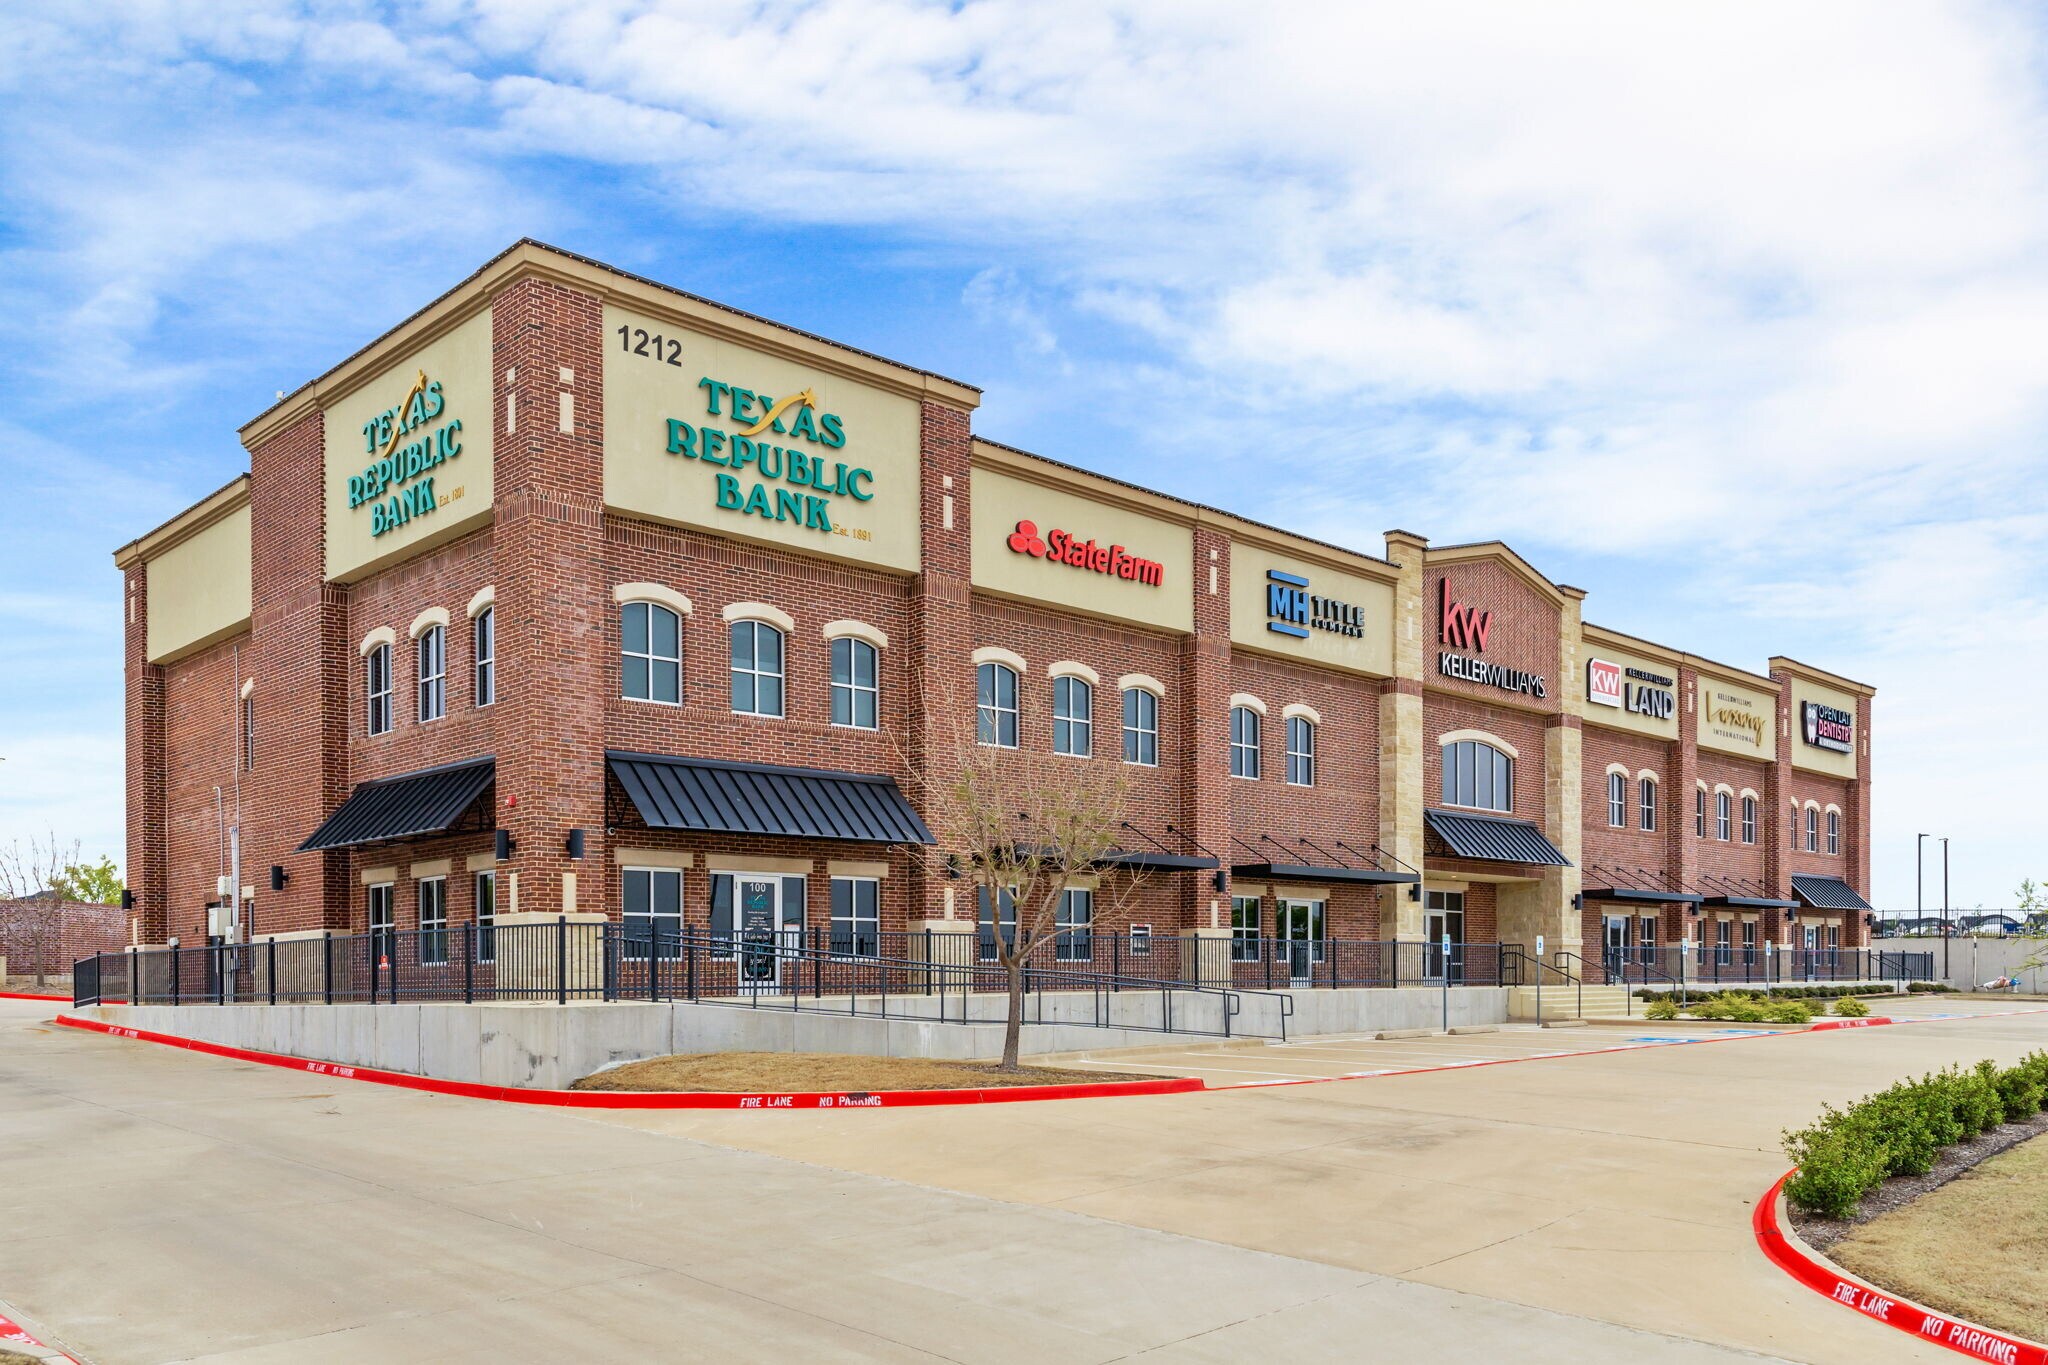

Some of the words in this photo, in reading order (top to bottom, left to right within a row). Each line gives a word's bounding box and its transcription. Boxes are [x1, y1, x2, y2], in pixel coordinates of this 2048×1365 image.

[618, 324, 682, 367] 1212
[362, 381, 445, 453] TEXAS
[698, 376, 847, 449] TEXAS
[347, 419, 463, 509] REPUBLIC
[666, 417, 874, 501] REPUBLIC
[370, 477, 437, 537] BANK
[716, 473, 833, 532] BANK
[1267, 584, 1309, 625] MH
[1311, 595, 1365, 628] TITLE
[1311, 618, 1366, 639] COMPANY
[1592, 667, 1619, 695] KW
[1624, 682, 1675, 720] LAND
[1818, 704, 1837, 722] OPEN
[750, 883, 766, 892] 100
[740, 1097, 762, 1108] FIRE
[767, 1096, 793, 1107] LANE
[819, 1096, 833, 1107] NO
[838, 1095, 882, 1106] PARKING
[1832, 1281, 1860, 1305] FIRE
[1860, 1292, 1895, 1320] LANE
[1921, 1316, 1944, 1337] NO
[1949, 1325, 2018, 1365] PARKING
